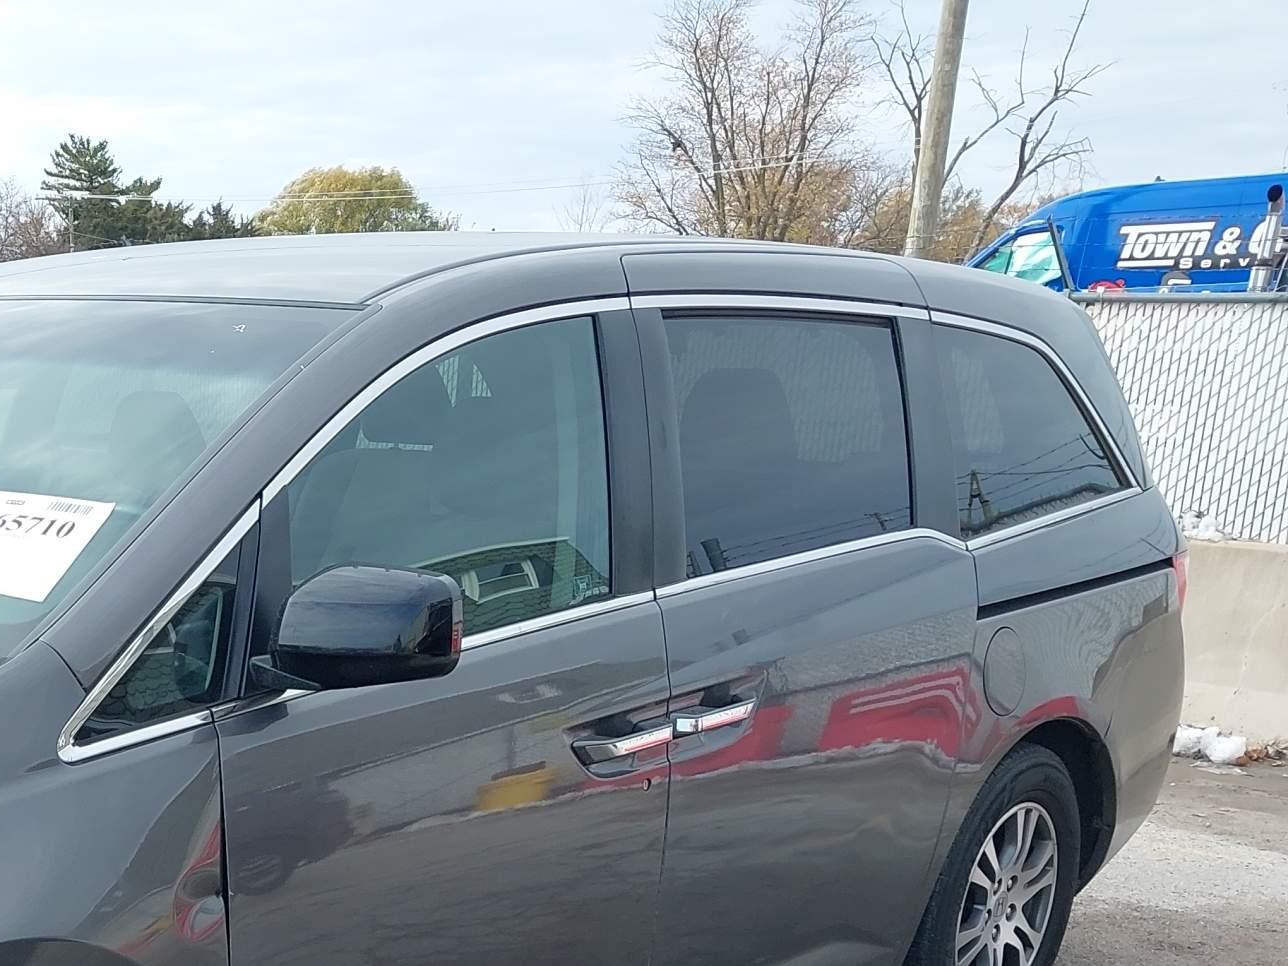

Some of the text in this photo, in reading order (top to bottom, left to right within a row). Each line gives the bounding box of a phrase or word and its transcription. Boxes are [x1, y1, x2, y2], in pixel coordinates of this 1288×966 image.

[1119, 222, 1216, 260] Town
[1214, 226, 1241, 255] &
[1179, 257, 1259, 269] Serv
